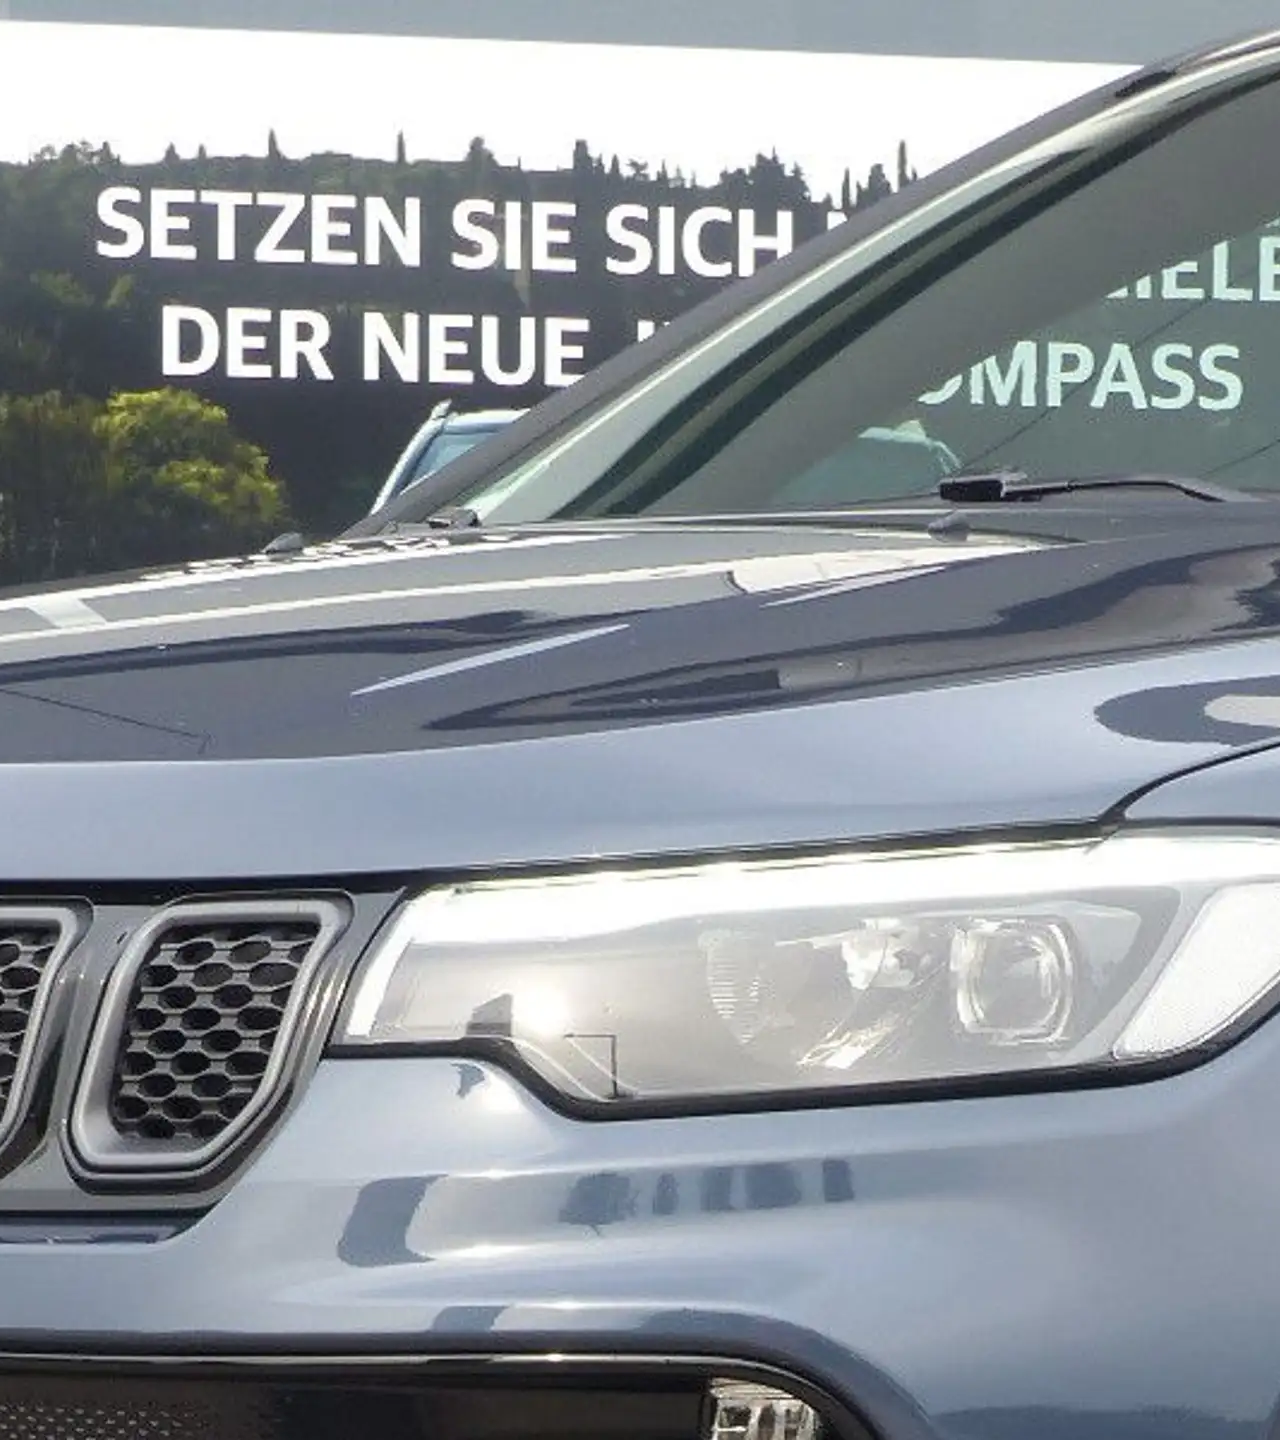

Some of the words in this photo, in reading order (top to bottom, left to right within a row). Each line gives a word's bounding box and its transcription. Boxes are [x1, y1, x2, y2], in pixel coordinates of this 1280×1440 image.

[96, 187, 421, 267] SETZEN
[451, 199, 577, 273] SIE
[606, 203, 793, 278] SICH
[162, 305, 334, 380] DER
[363, 311, 590, 388] NEUE
[919, 340, 1245, 411] MPASS
